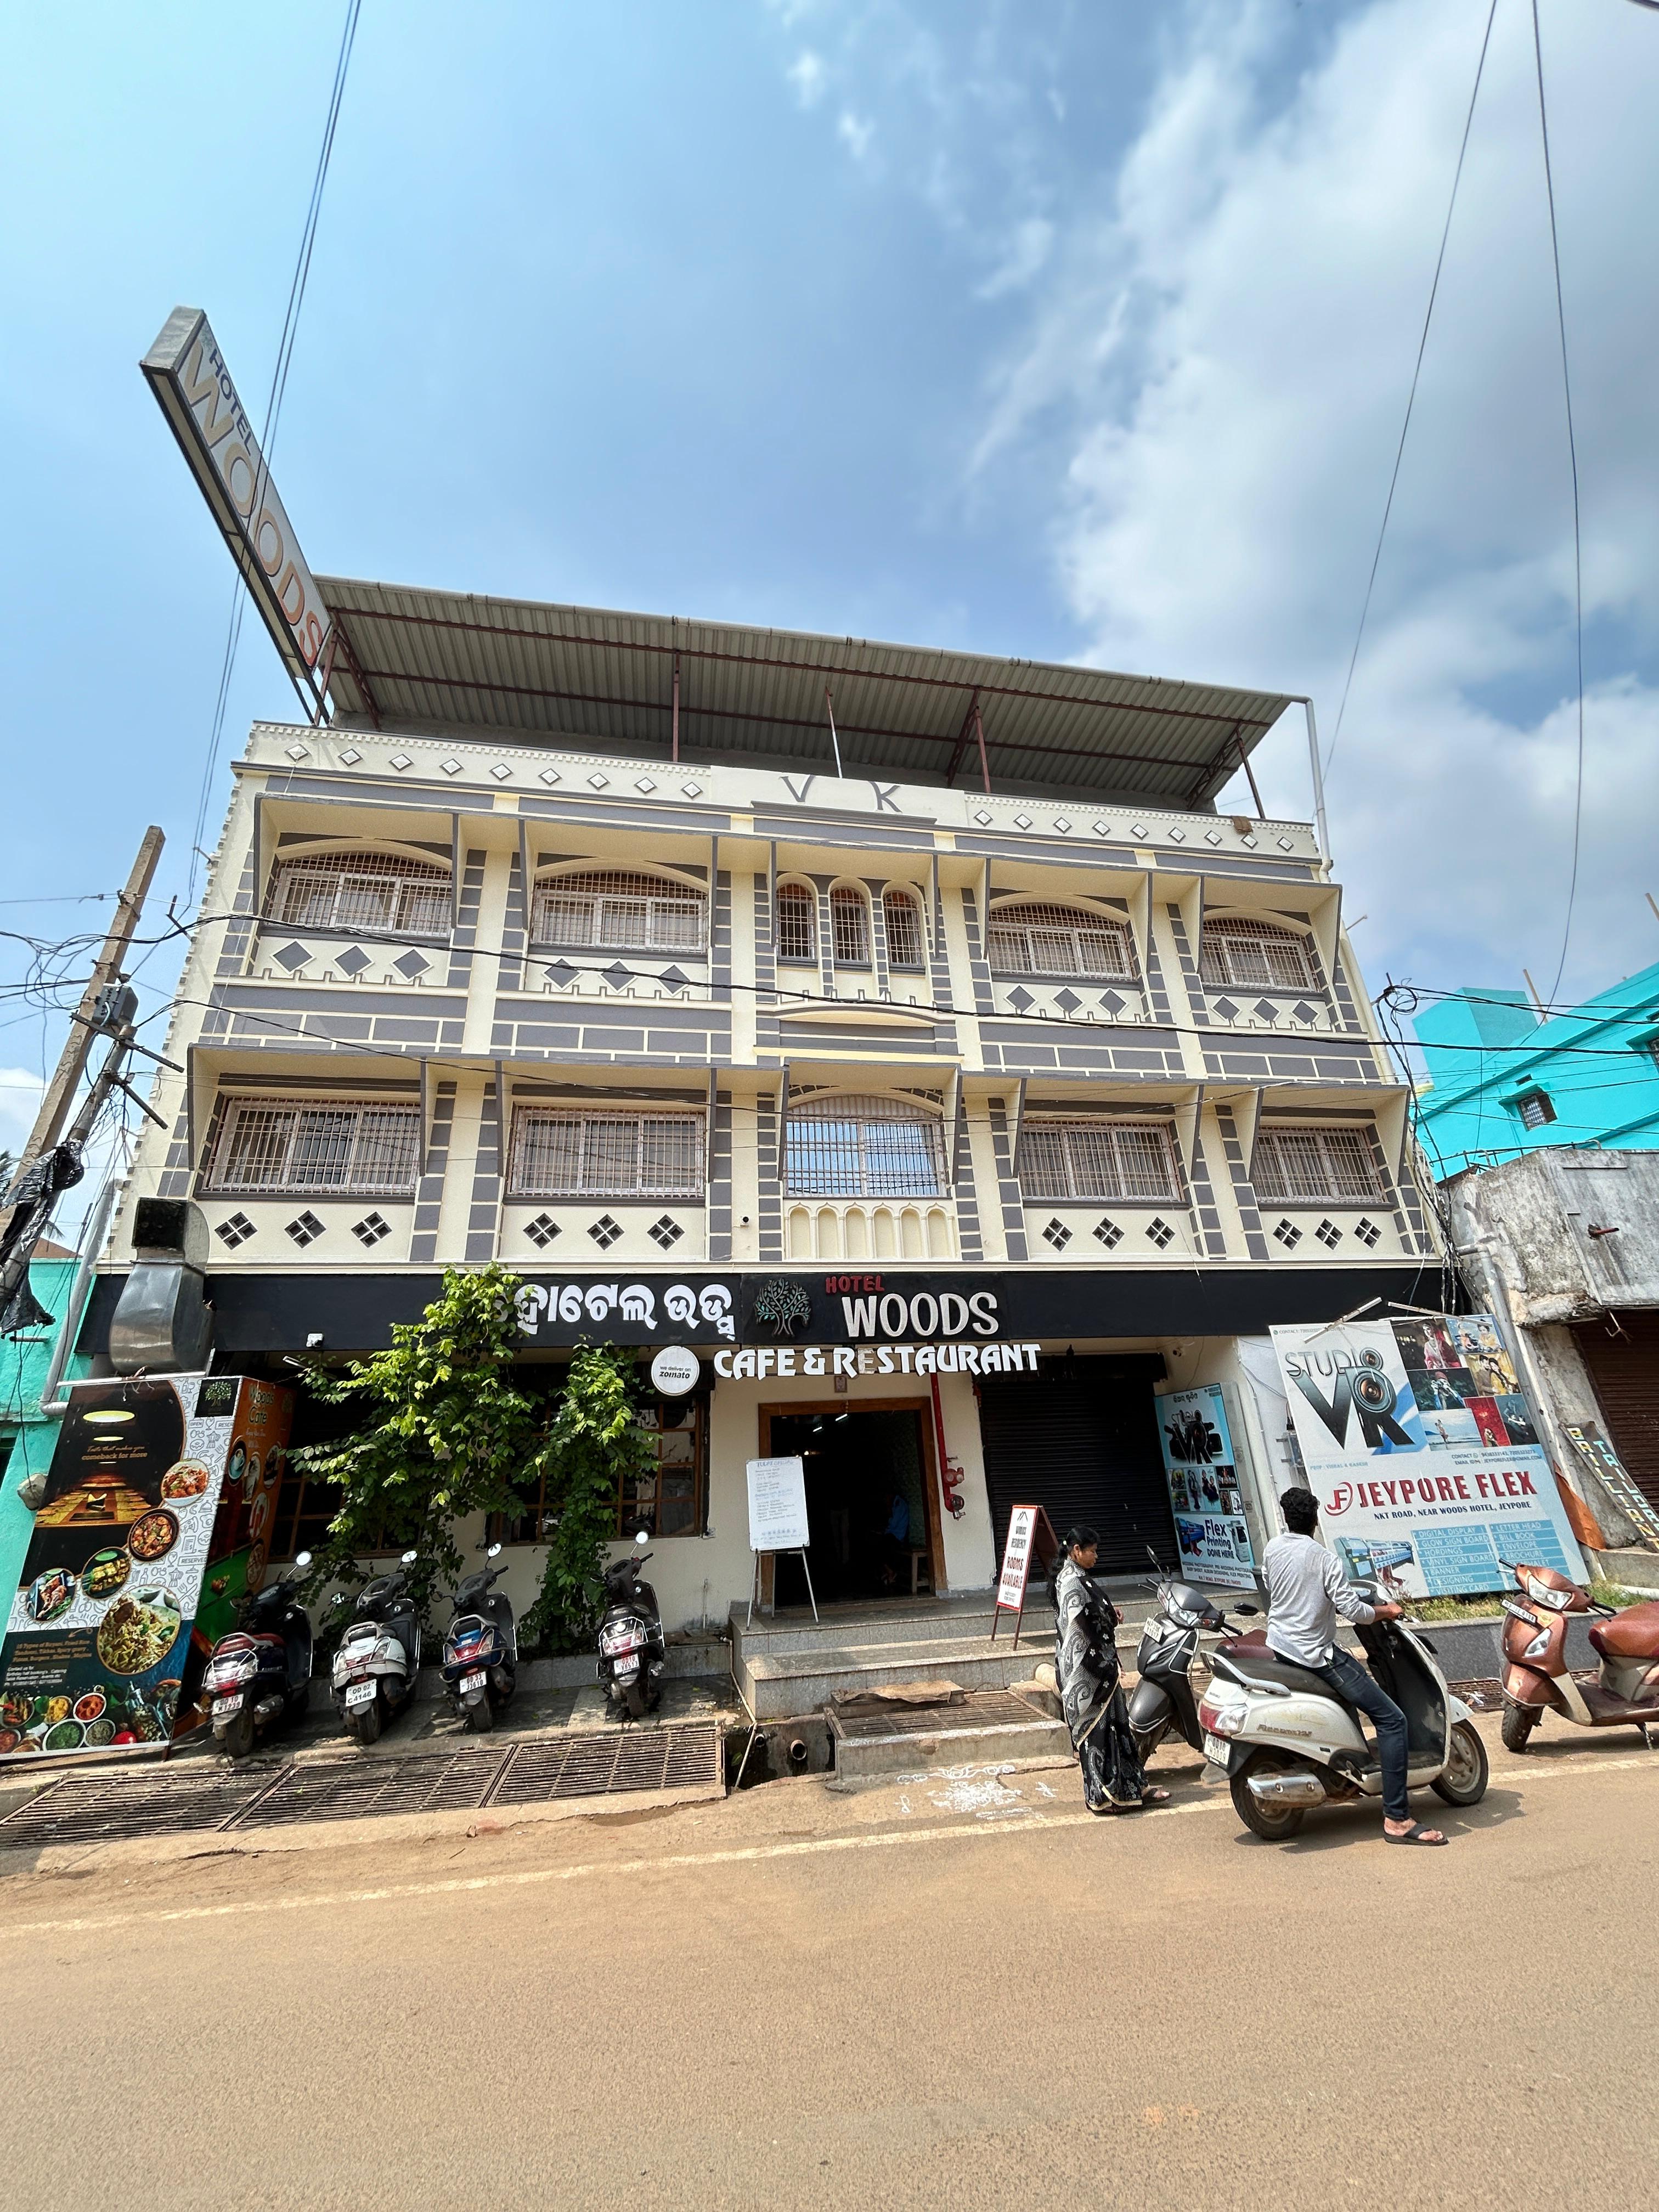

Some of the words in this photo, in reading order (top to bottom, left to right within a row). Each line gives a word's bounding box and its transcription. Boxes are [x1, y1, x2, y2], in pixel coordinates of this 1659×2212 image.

[209, 348, 252, 456] HOTEL
[184, 337, 323, 668] WOODS
[778, 774, 816, 803] V
[868, 781, 903, 813] K
[825, 1276, 885, 1294] HOTEL
[842, 1292, 998, 1338] WOODS
[714, 1347, 796, 1380] CAFE
[803, 1347, 825, 1375] &
[833, 1344, 1041, 1378] RESTAURANT
[1285, 1347, 1384, 1377] STUDIO
[1286, 1365, 1416, 1450] VR
[1357, 1475, 1471, 1508] JEYPORE
[1475, 1471, 1537, 1498] FLEX
[1374, 1512, 1390, 1520] NKT
[1391, 1509, 1416, 1519] ROAD,
[1418, 1508, 1438, 1517] NEAR
[1441, 1505, 1468, 1515] WOODS
[1470, 1503, 1497, 1513] HOTEL,
[1499, 1501, 1531, 1510] JEYPORE
[1205, 1519, 1227, 1537] Flex
[1448, 1527, 1475, 1535] DISPLAY
[1207, 1536, 1231, 1550] Printing
[1421, 1539, 1443, 1547] GLOW
[1464, 1535, 1490, 1543] BOARD
[1498, 1533, 1514, 1541] BILL
[1425, 1547, 1464, 1557] HORDINGS
[1502, 1541, 1538, 1550] ENVELOPE
[1207, 1548, 1221, 1558] DONE
[1221, 1550, 1234, 1559] HERE
[1451, 1555, 1468, 1564] SIGN
[1505, 1550, 1544, 1560] BROCHURE
[1007, 1556, 1024, 1571] ROOMS
[1430, 1567, 1460, 1576] BANNER
[1002, 1572, 1023, 1589] AVAILABLE
[1434, 1575, 1474, 1585] DESIGNING
[1436, 1586, 1468, 1595] VISITING
